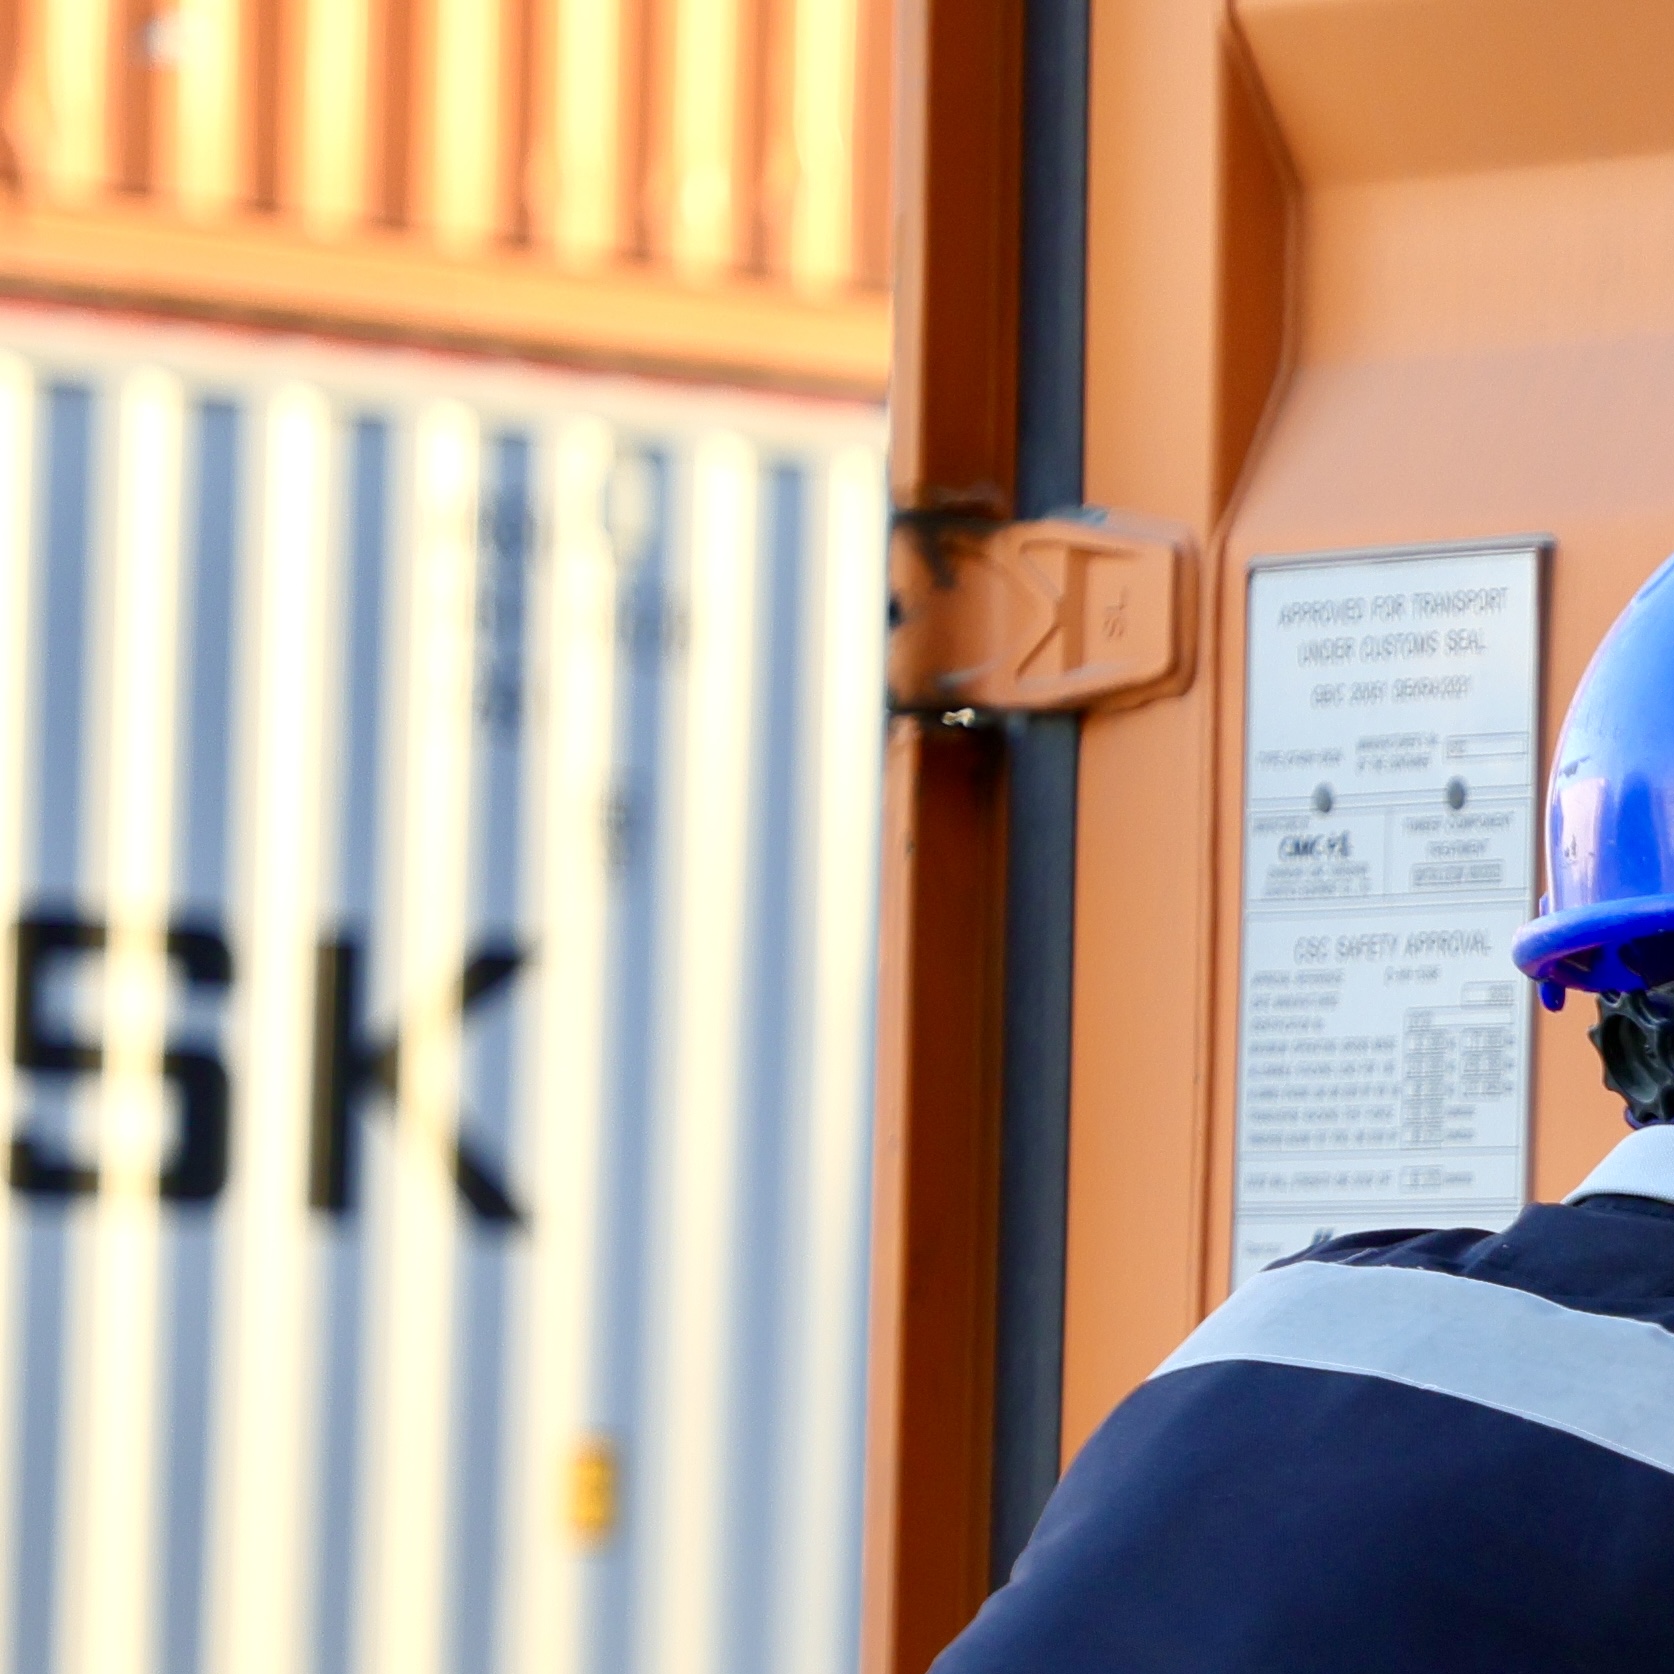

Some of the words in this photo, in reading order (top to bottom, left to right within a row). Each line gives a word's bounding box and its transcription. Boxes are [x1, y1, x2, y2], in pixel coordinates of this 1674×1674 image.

[1278, 597, 1366, 630] APPROVED
[1370, 593, 1407, 621] FOR
[1411, 586, 1509, 619] TRANSPORT
[1297, 637, 1355, 666] UNDER
[1359, 630, 1441, 662] CUSTOMS
[1444, 628, 1488, 653] SEAL
[1293, 936, 1331, 964] CSC
[1335, 932, 1397, 962] SAFETY
[1403, 928, 1493, 959] APPROVAL
[5, 903, 535, 1238] SK
